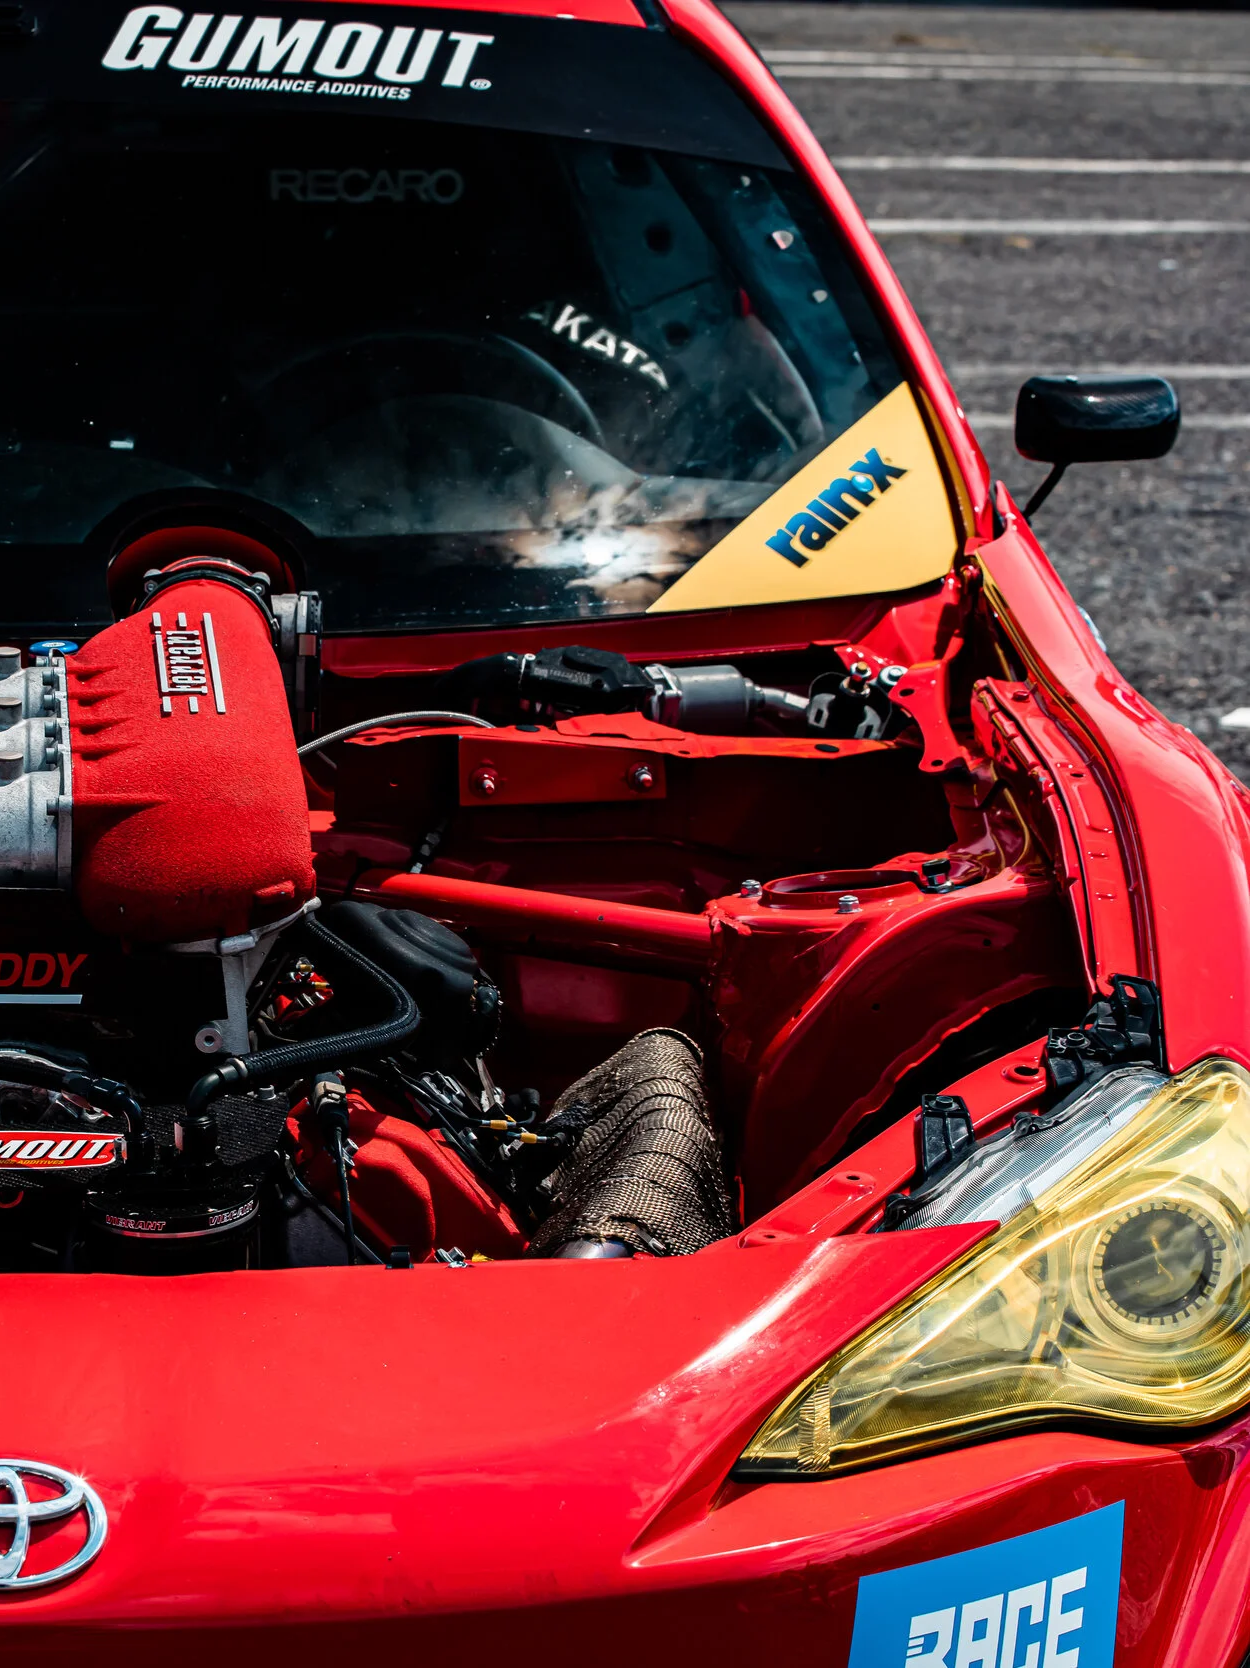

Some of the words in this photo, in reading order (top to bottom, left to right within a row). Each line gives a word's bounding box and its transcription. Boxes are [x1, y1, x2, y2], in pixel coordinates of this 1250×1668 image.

[182, 74, 315, 94] PERFORMANCE
[316, 81, 412, 100] ADDITIVES
[269, 168, 464, 204] RECARO
[16, 1158, 66, 1166] ADDITIVES
[105, 1214, 167, 1232] VIBRANT
